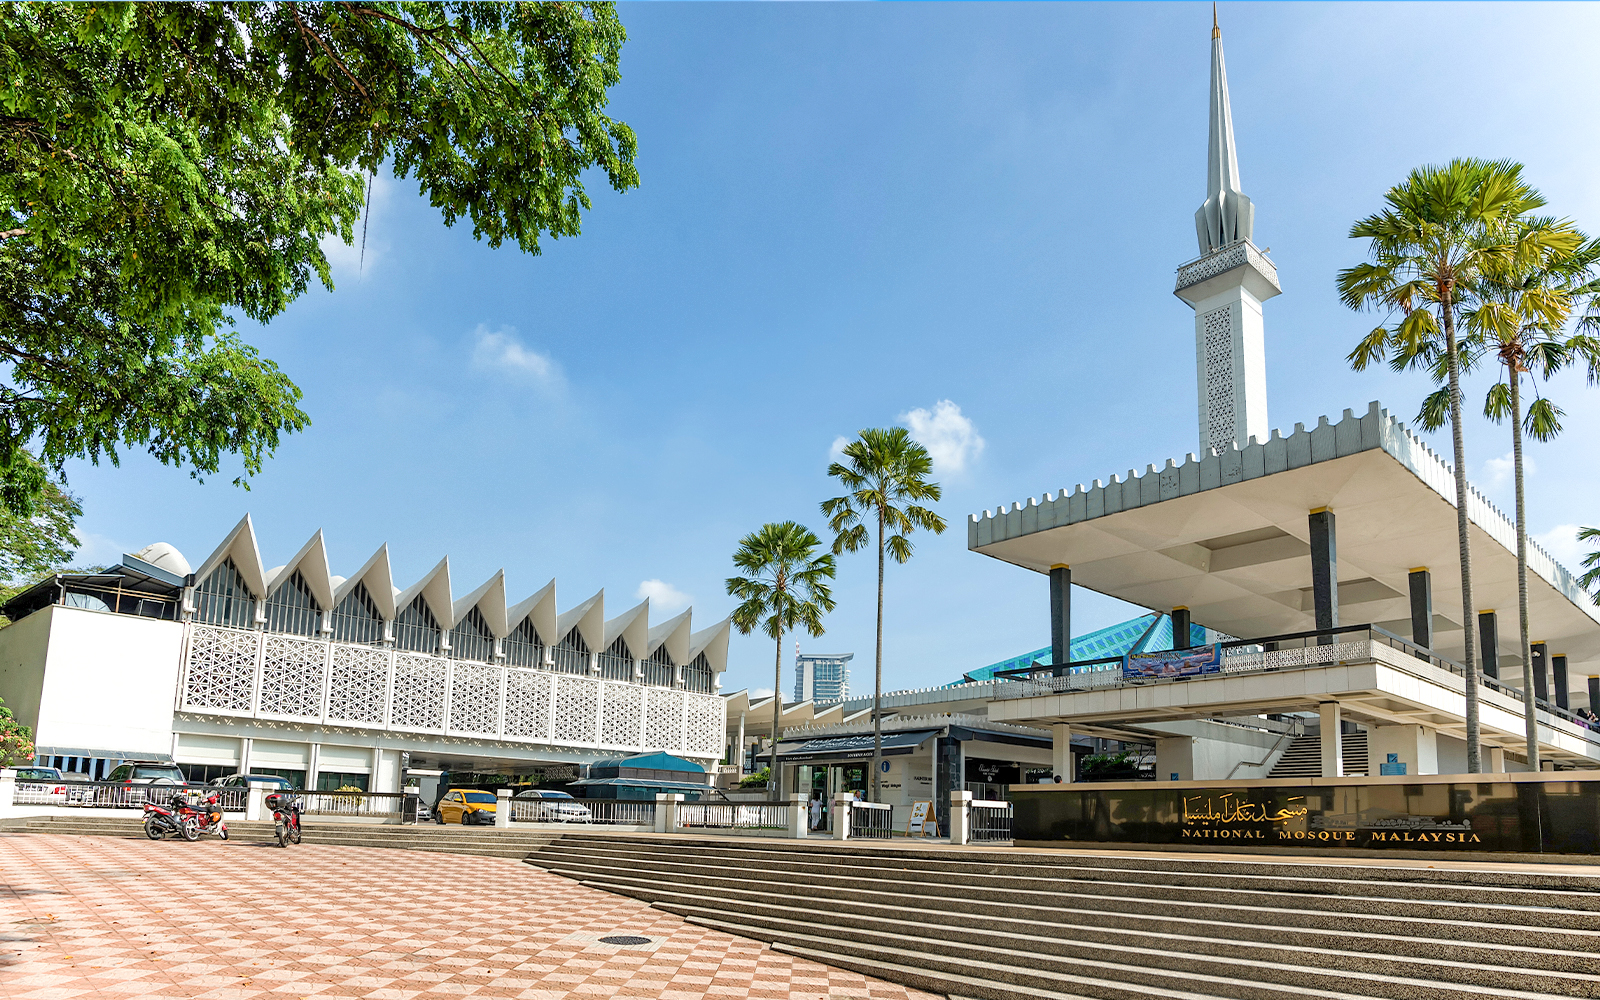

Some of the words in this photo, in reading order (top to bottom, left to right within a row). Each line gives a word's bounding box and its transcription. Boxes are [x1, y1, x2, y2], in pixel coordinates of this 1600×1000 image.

[1181, 829, 1265, 839] NATIONAL
[1279, 831, 1356, 842] MOSQUE
[1371, 831, 1481, 843] MALAYSIA
